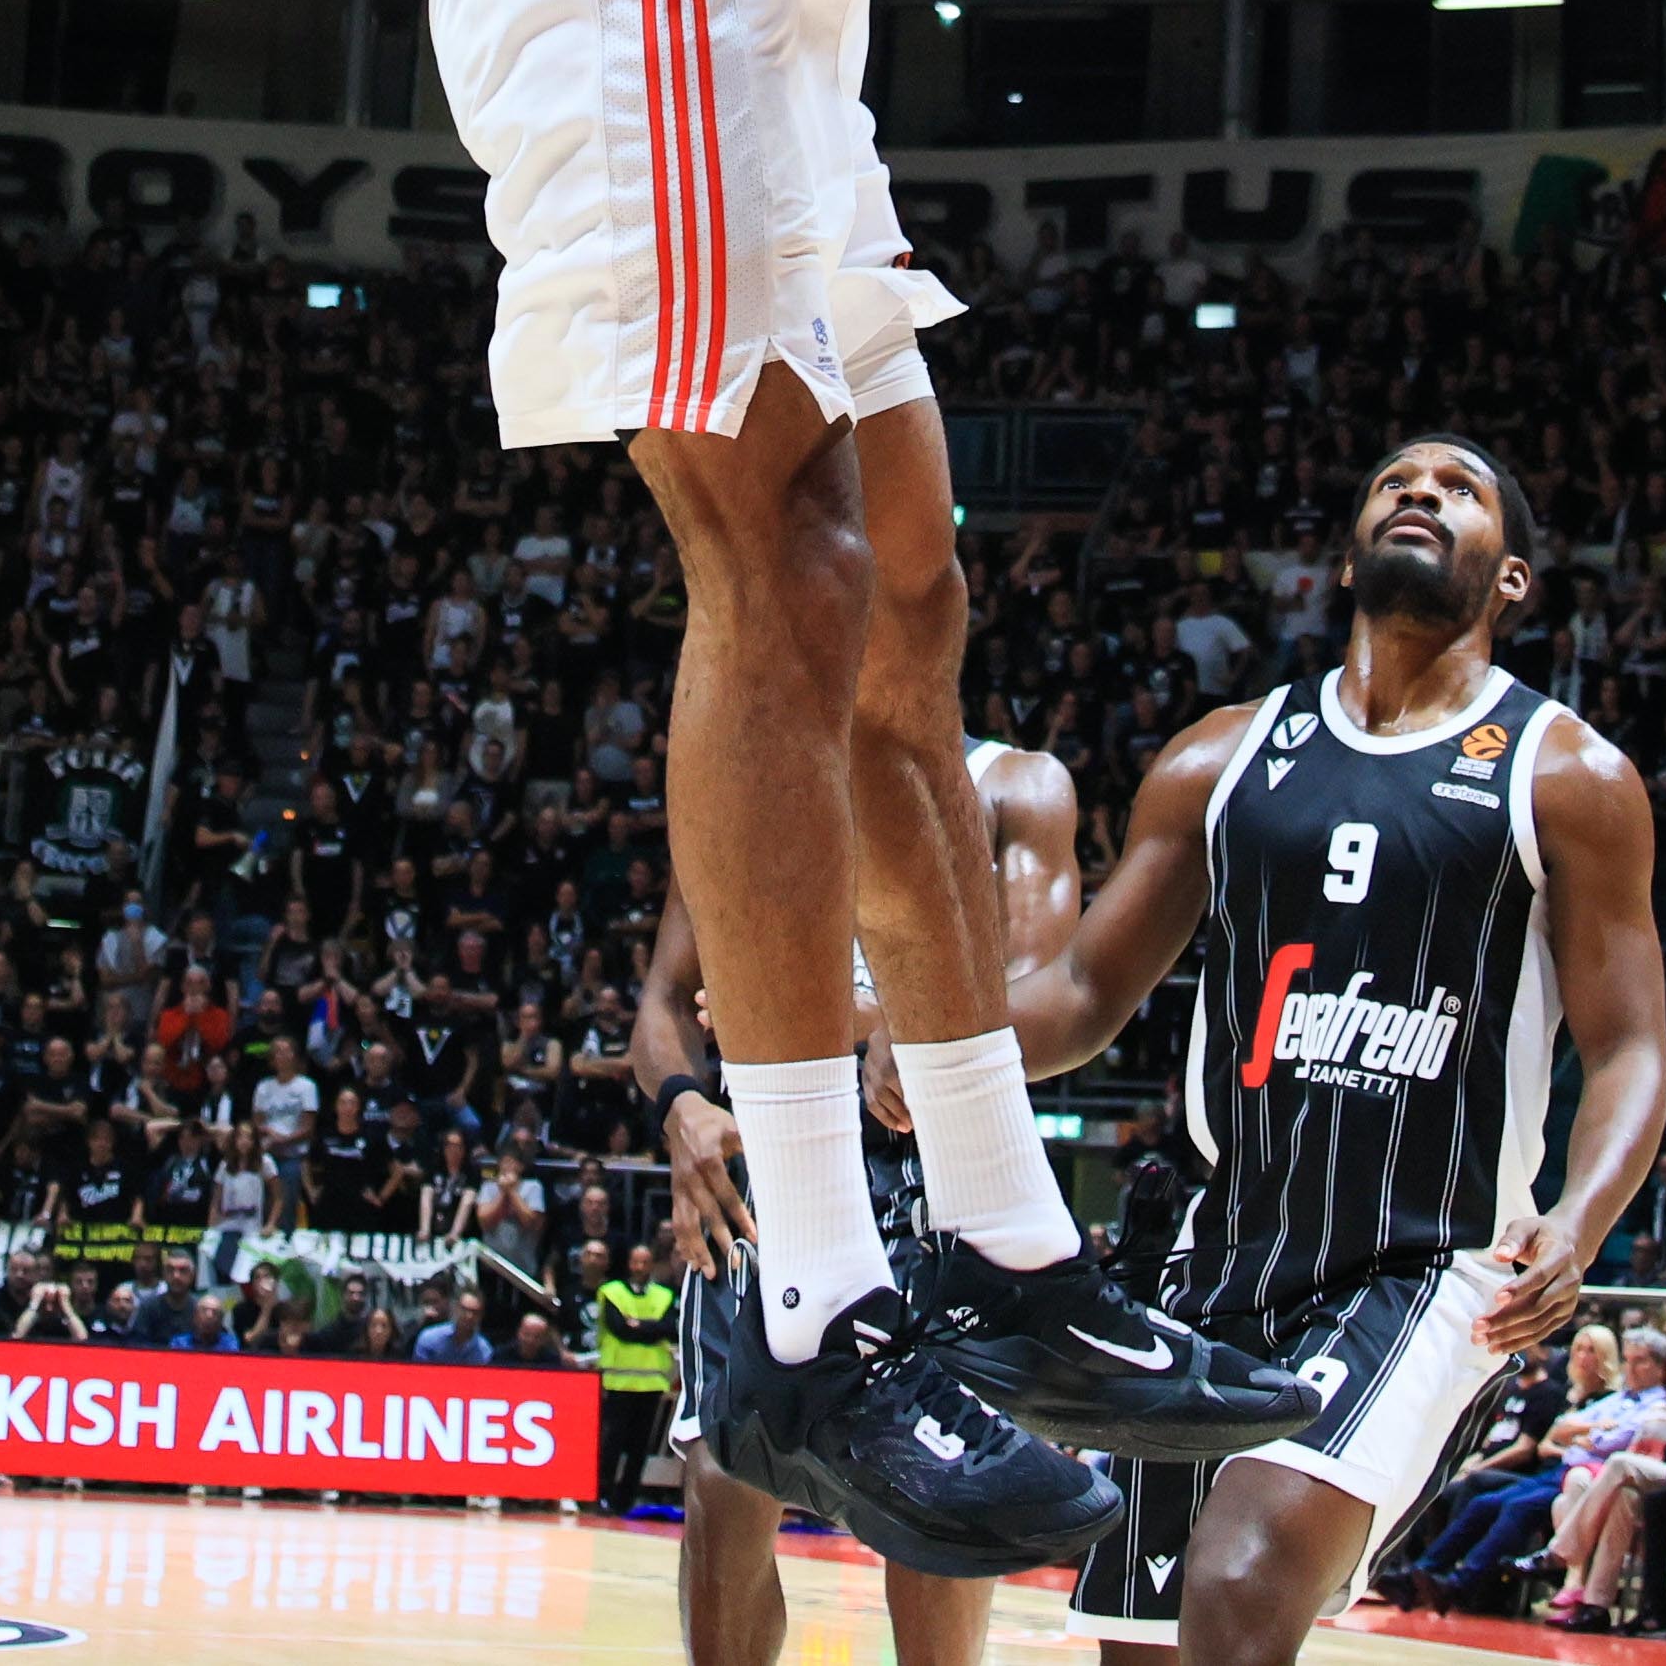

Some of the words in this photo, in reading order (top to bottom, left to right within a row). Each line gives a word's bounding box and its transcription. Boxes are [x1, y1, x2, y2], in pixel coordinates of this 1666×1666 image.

[1323, 822, 1380, 904] 9
[1242, 943, 1459, 1088] Segafredo
[1311, 1064, 1399, 1097] ZANETTI
[198, 1384, 556, 1467] AIRLINES
